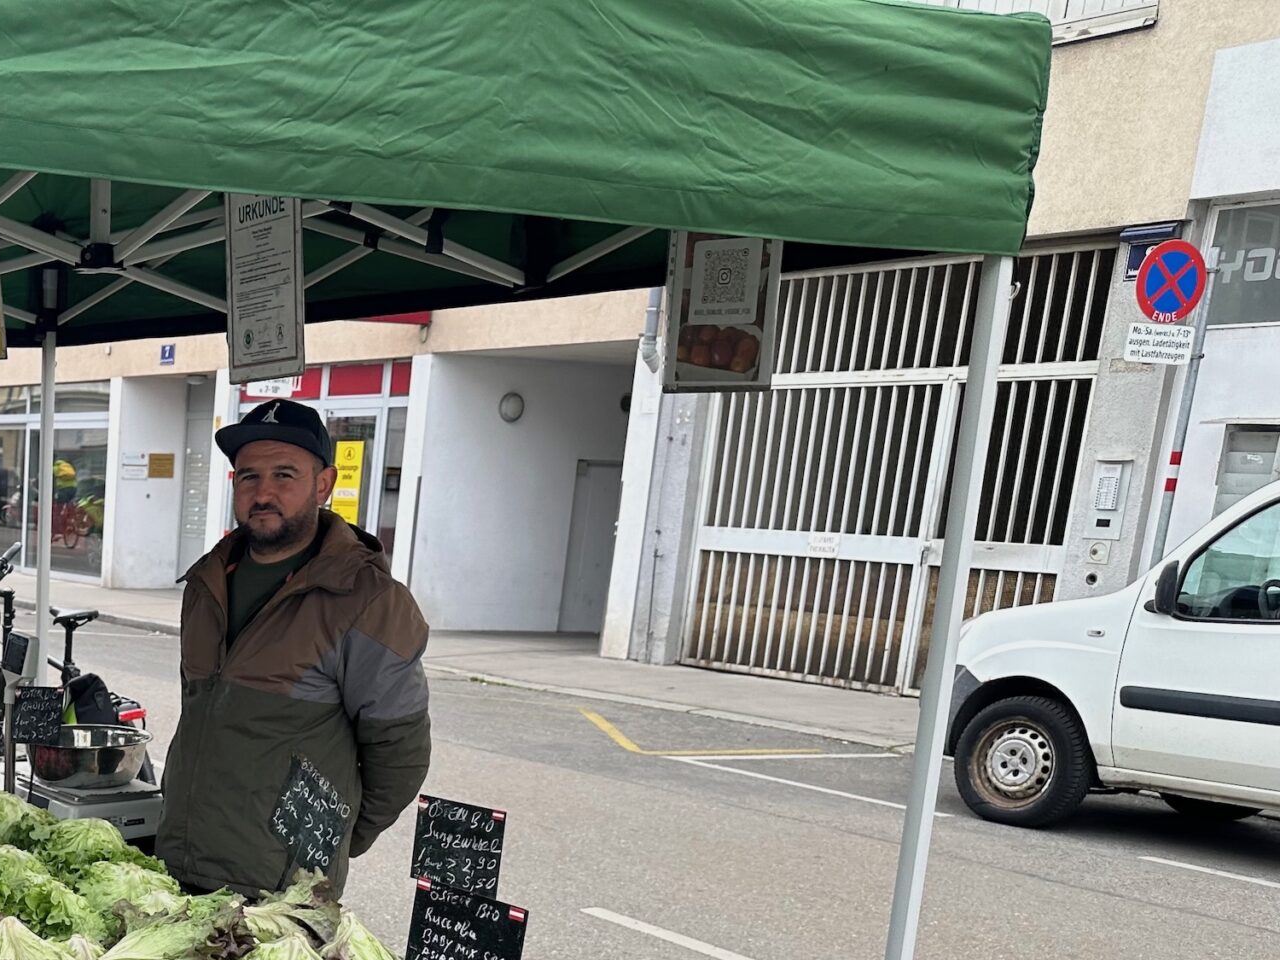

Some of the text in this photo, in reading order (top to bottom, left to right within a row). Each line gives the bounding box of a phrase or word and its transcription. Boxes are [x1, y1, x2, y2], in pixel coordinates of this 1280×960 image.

[238, 196, 285, 224] URKUNDE
[1151, 310, 1178, 323] ENDE
[1130, 349, 1140, 357] mit
